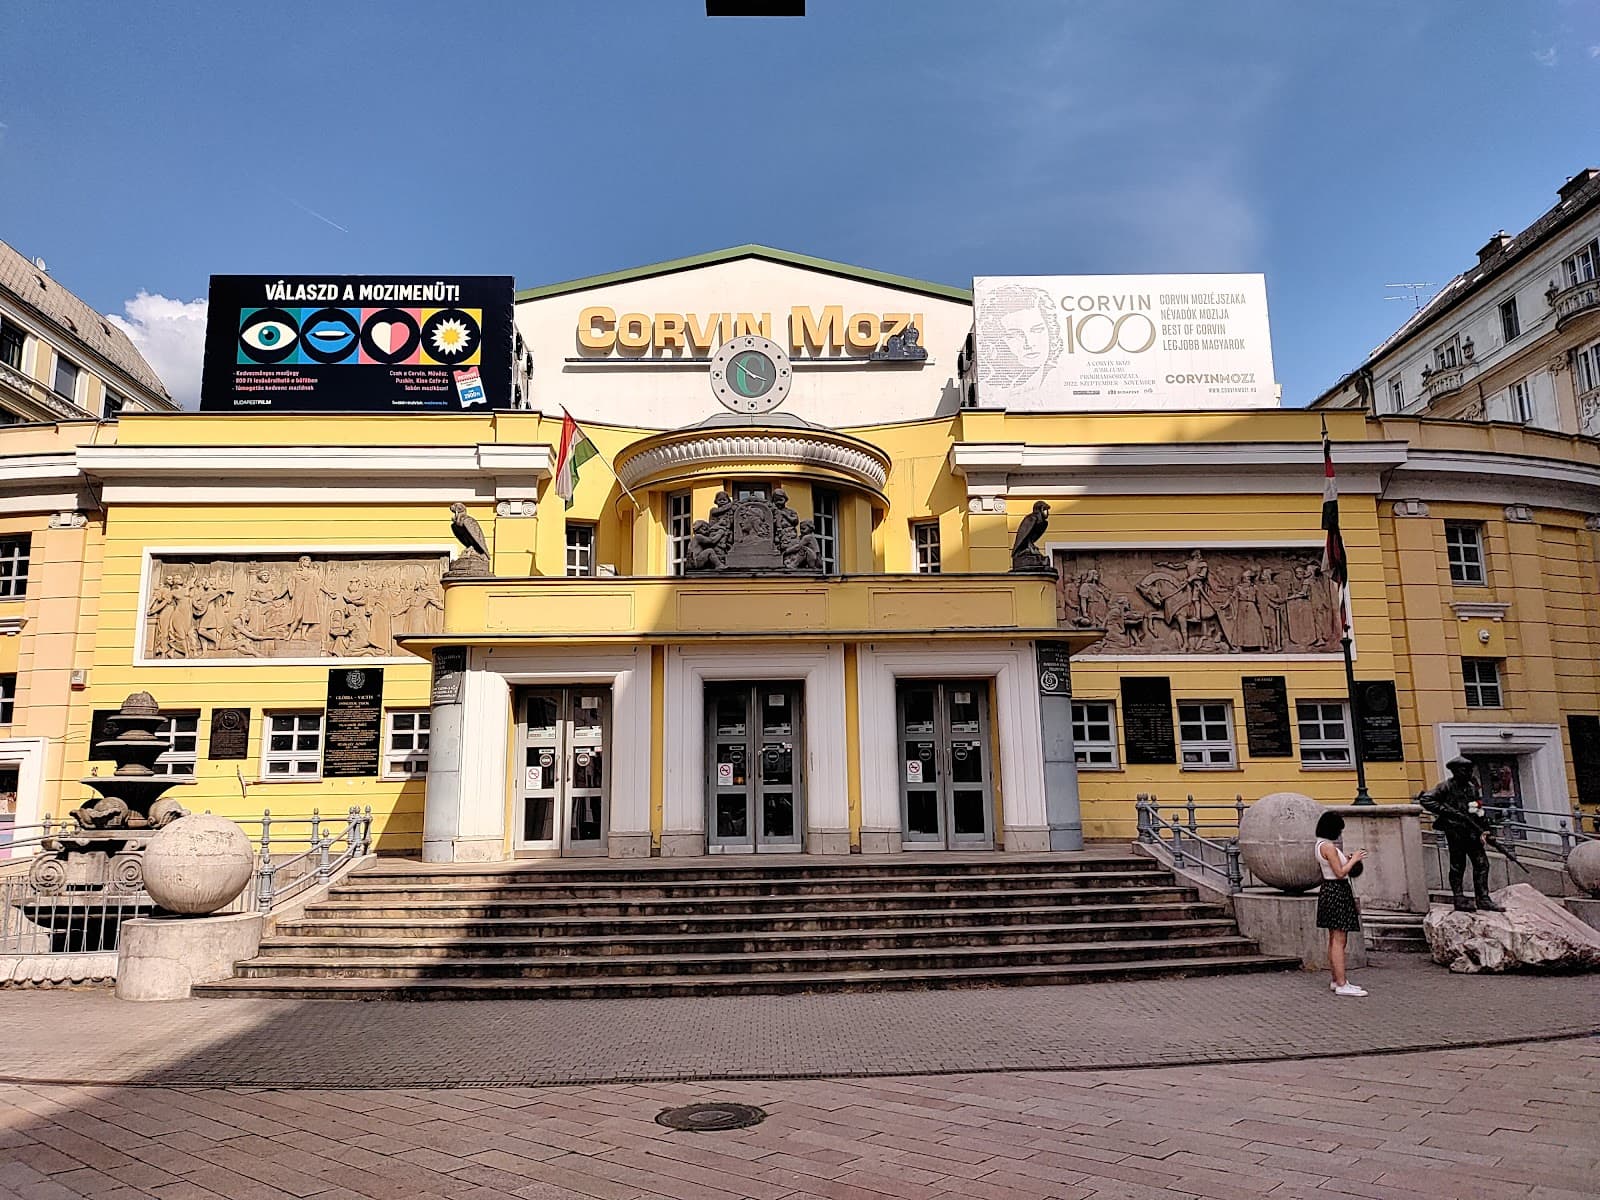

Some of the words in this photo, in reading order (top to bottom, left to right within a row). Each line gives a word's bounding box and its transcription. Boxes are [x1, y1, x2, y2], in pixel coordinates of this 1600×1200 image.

[265, 280, 338, 301] VÁLASZD
[343, 284, 354, 300] A
[359, 283, 460, 302] MOZIMENÜT!
[1060, 294, 1152, 312] CORVIN
[1159, 294, 1189, 305] CORVIN
[1191, 292, 1246, 305] MOZIÉJSZAKA
[1160, 307, 1197, 320] NÉVADÓK
[1199, 309, 1229, 320] MOZIJA
[1066, 313, 1157, 354] 100
[1162, 324, 1181, 335] BEST
[1183, 324, 1193, 335] OF
[1196, 324, 1226, 335] CORVIN
[1163, 339, 1200, 350] LEGJOBB
[1202, 338, 1245, 350] MAGYAROK
[1165, 373, 1256, 384] CORVINMOZI
